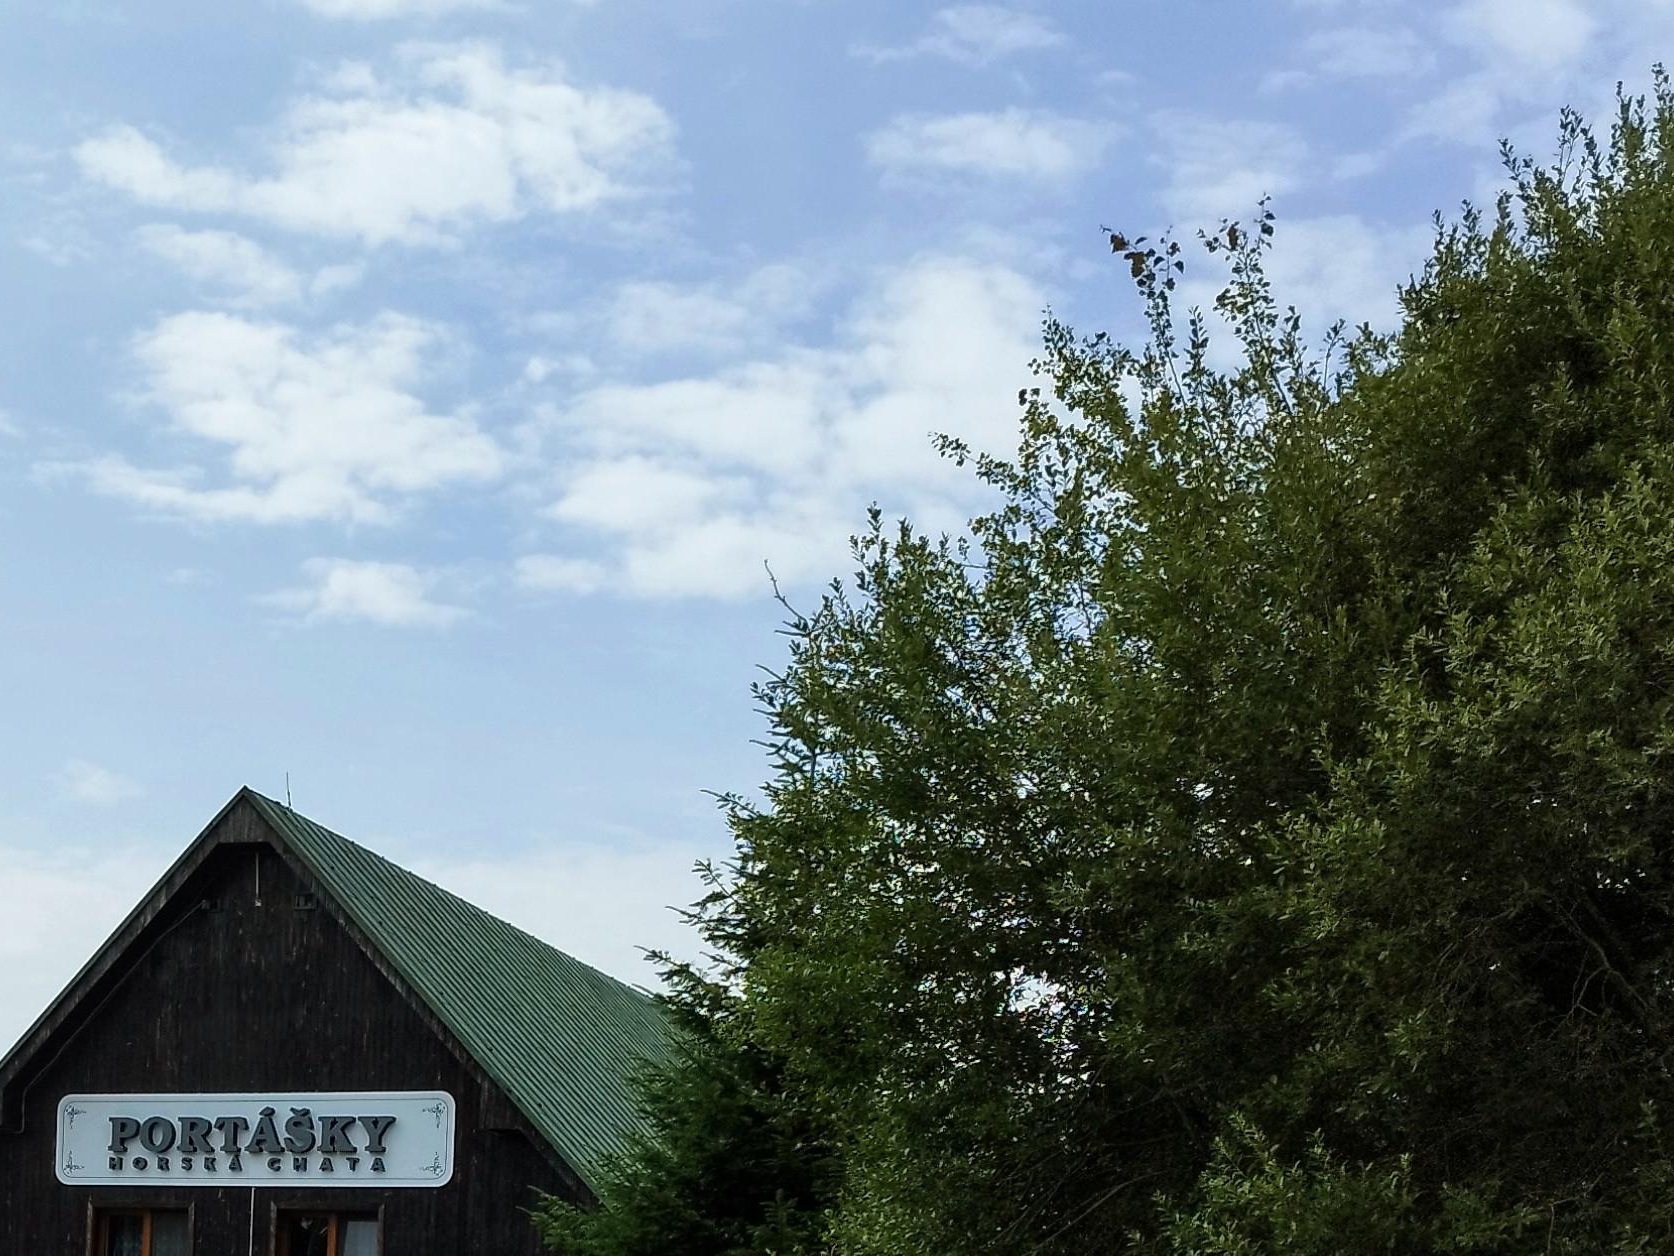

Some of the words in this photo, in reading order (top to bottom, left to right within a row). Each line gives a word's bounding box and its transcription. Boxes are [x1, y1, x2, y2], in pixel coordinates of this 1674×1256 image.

[107, 1106, 398, 1154] PORTÁŠKY
[108, 1153, 242, 1172] HORSKÁ
[267, 1156, 387, 1173] CHATA
